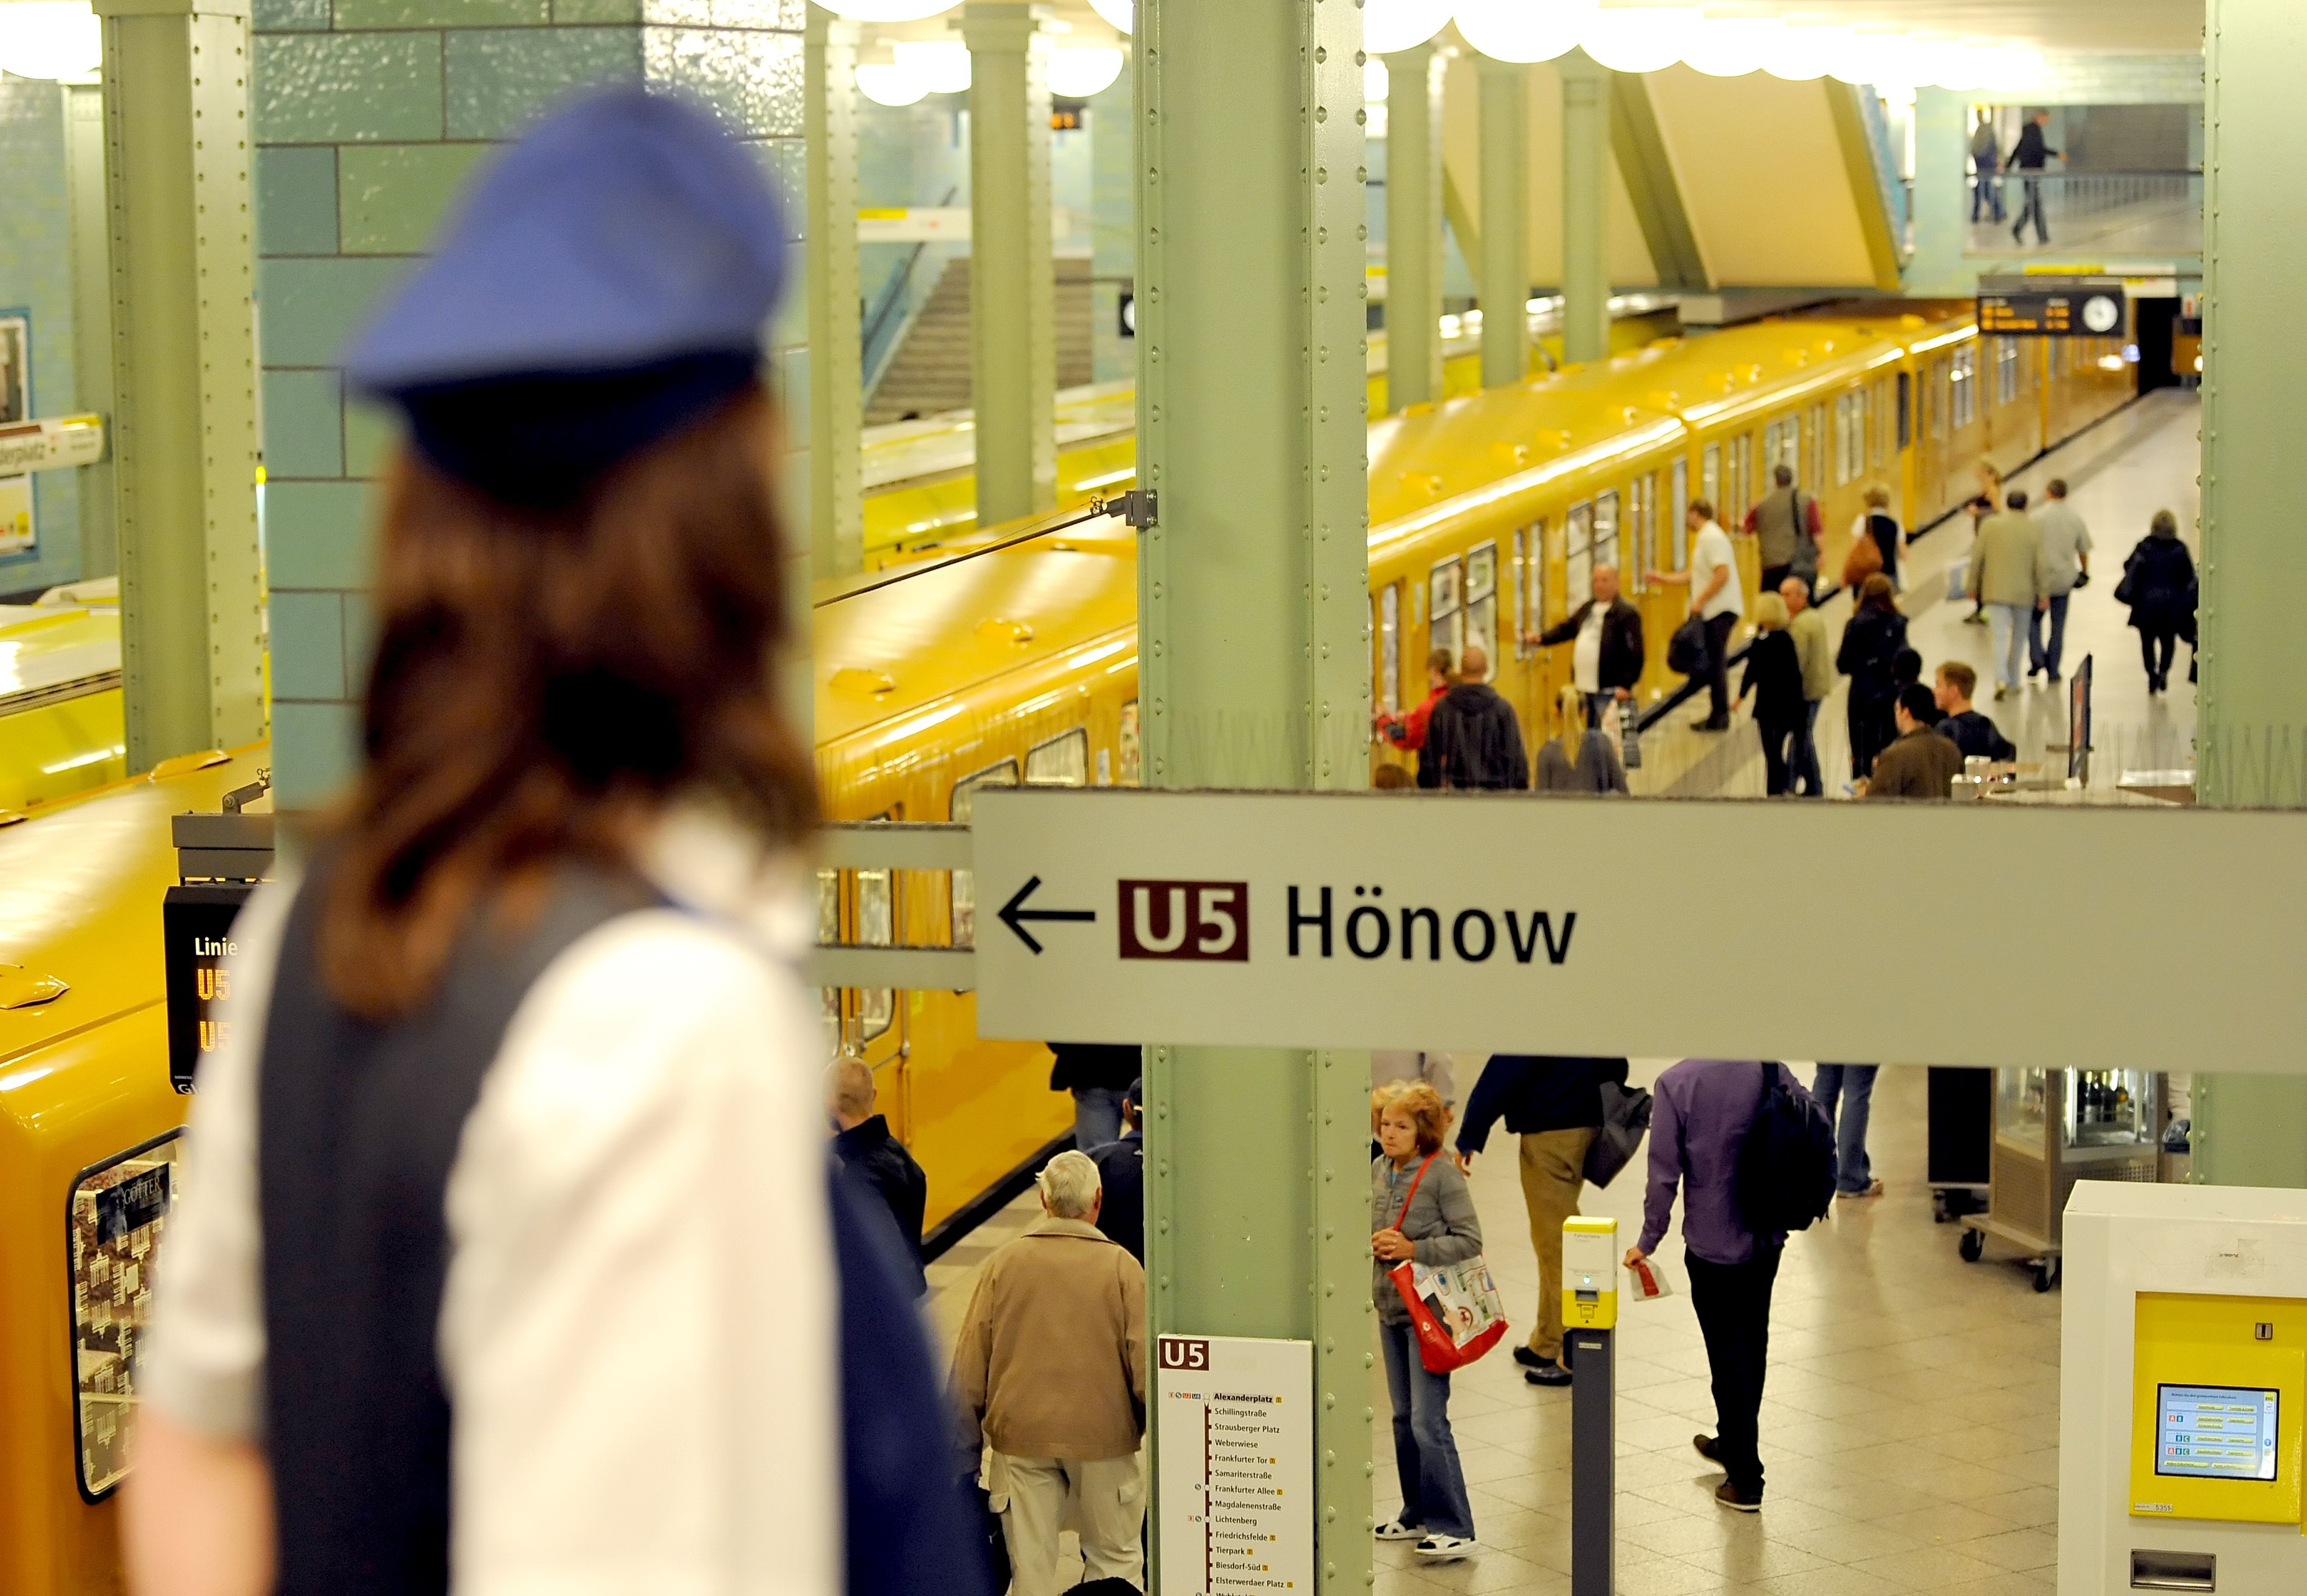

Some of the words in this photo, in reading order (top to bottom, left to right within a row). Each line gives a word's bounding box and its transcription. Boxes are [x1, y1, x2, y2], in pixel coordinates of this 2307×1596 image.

[1132, 886, 1237, 954] U5
[1287, 885, 1577, 965] Hönow
[195, 937, 238, 956] Linie
[197, 968, 231, 1001] U5
[200, 1020, 233, 1053] U5
[1165, 1341, 1204, 1368] U5
[1214, 1393, 1273, 1403] Alexanderplatz
[1214, 1408, 1267, 1418] Schillingstraße
[1214, 1423, 1260, 1434] Strausberger
[1262, 1425, 1280, 1433] Platz
[1214, 1439, 1259, 1448] Weberwiese
[1214, 1454, 1254, 1463] Frankfurter
[1257, 1456, 1268, 1464] Tor
[1215, 1469, 1272, 1480] Samariterstraße
[1215, 1485, 1255, 1494] Frankfurter
[1257, 1487, 1275, 1495] Allee
[1215, 1500, 1282, 1511] Magdalenenstraße
[1215, 1515, 1257, 1526] Lichtenberg
[1216, 1531, 1268, 1541] Friedrichsfelde
[1216, 1546, 1245, 1556] Tierpark
[1216, 1561, 1261, 1571] Biesdorf-Süd
[1216, 1576, 1265, 1587] Elsterwerdaer
[1267, 1580, 1285, 1588] Platz
